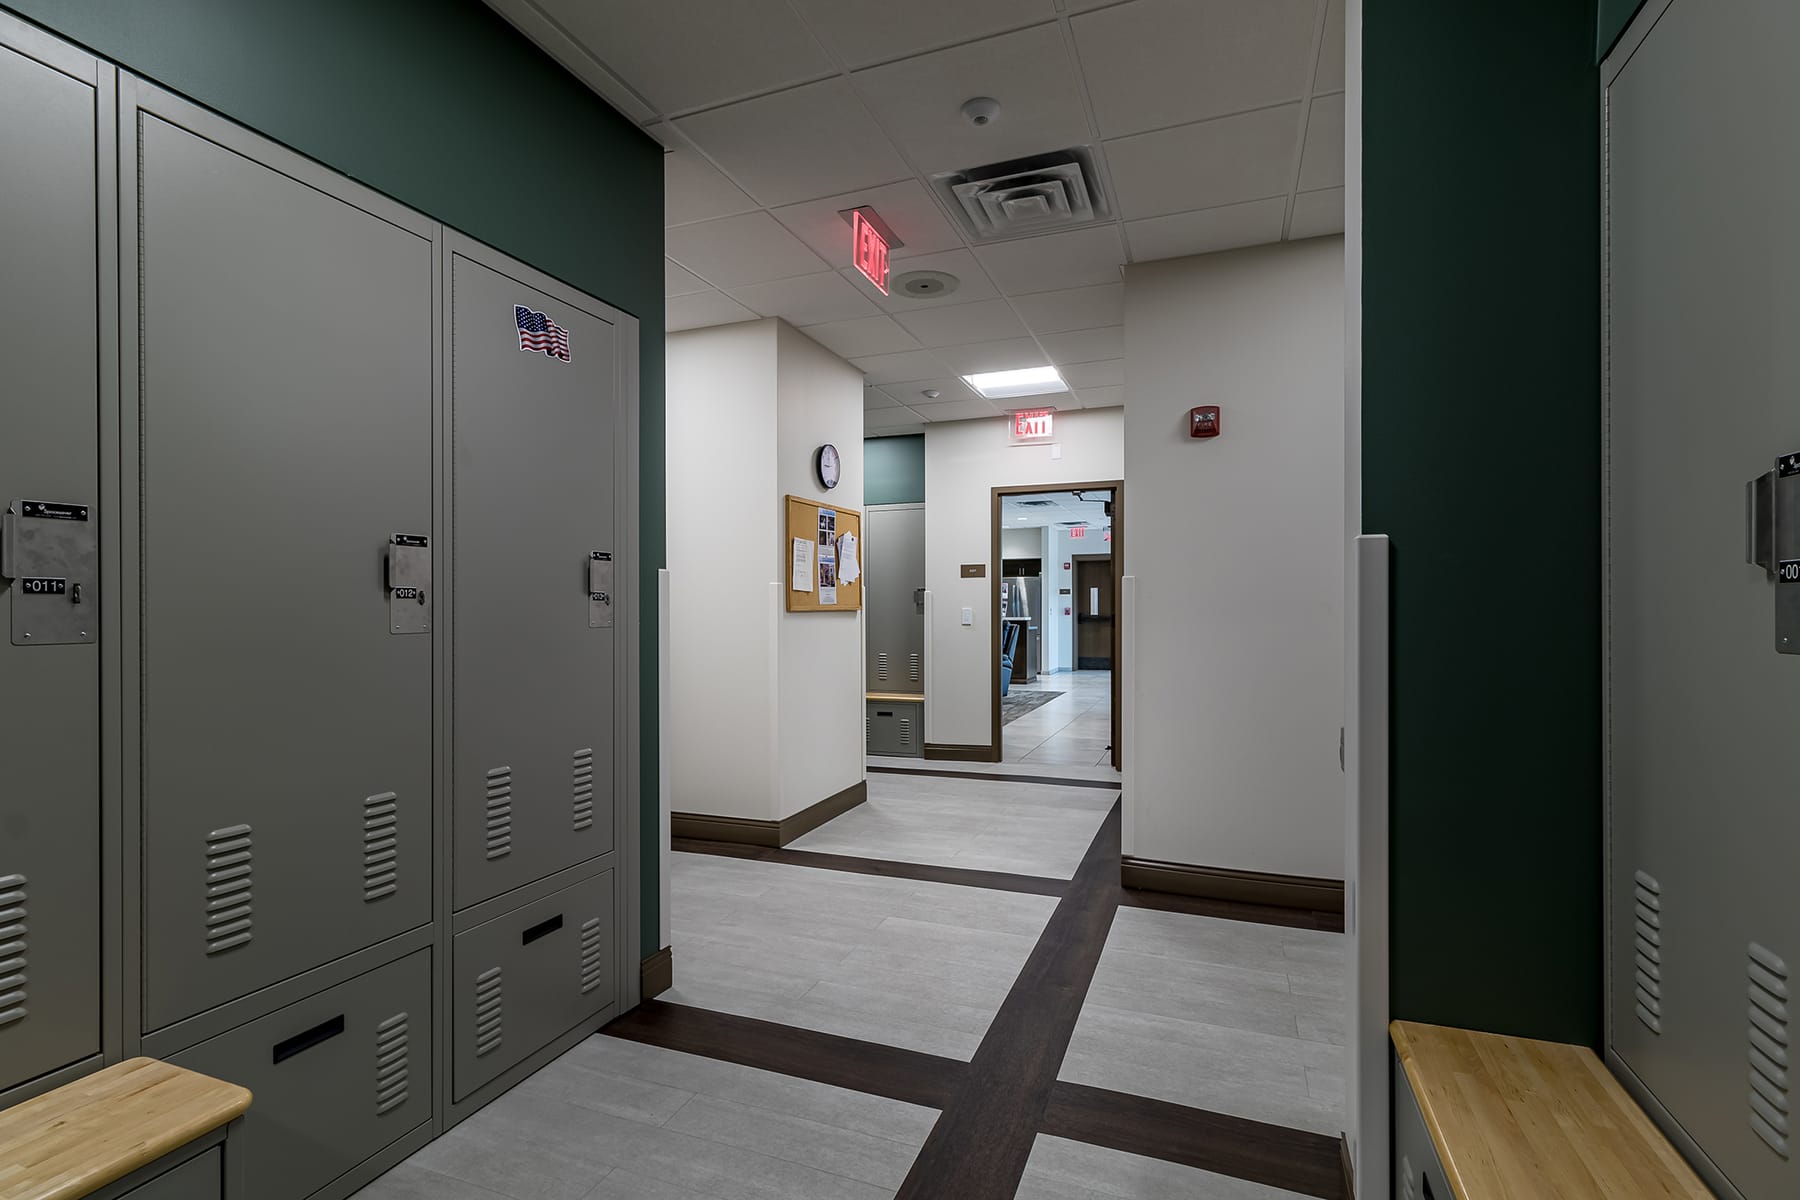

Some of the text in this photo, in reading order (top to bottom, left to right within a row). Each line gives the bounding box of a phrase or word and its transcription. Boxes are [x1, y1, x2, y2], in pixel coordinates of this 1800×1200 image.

[860, 222, 887, 286] EXIT
[1015, 411, 1049, 435] EXIT
[1070, 527, 1085, 537] EXIT
[1785, 563, 1800, 579] 00
[32, 580, 57, 592] 011
[399, 589, 413, 598] 012
